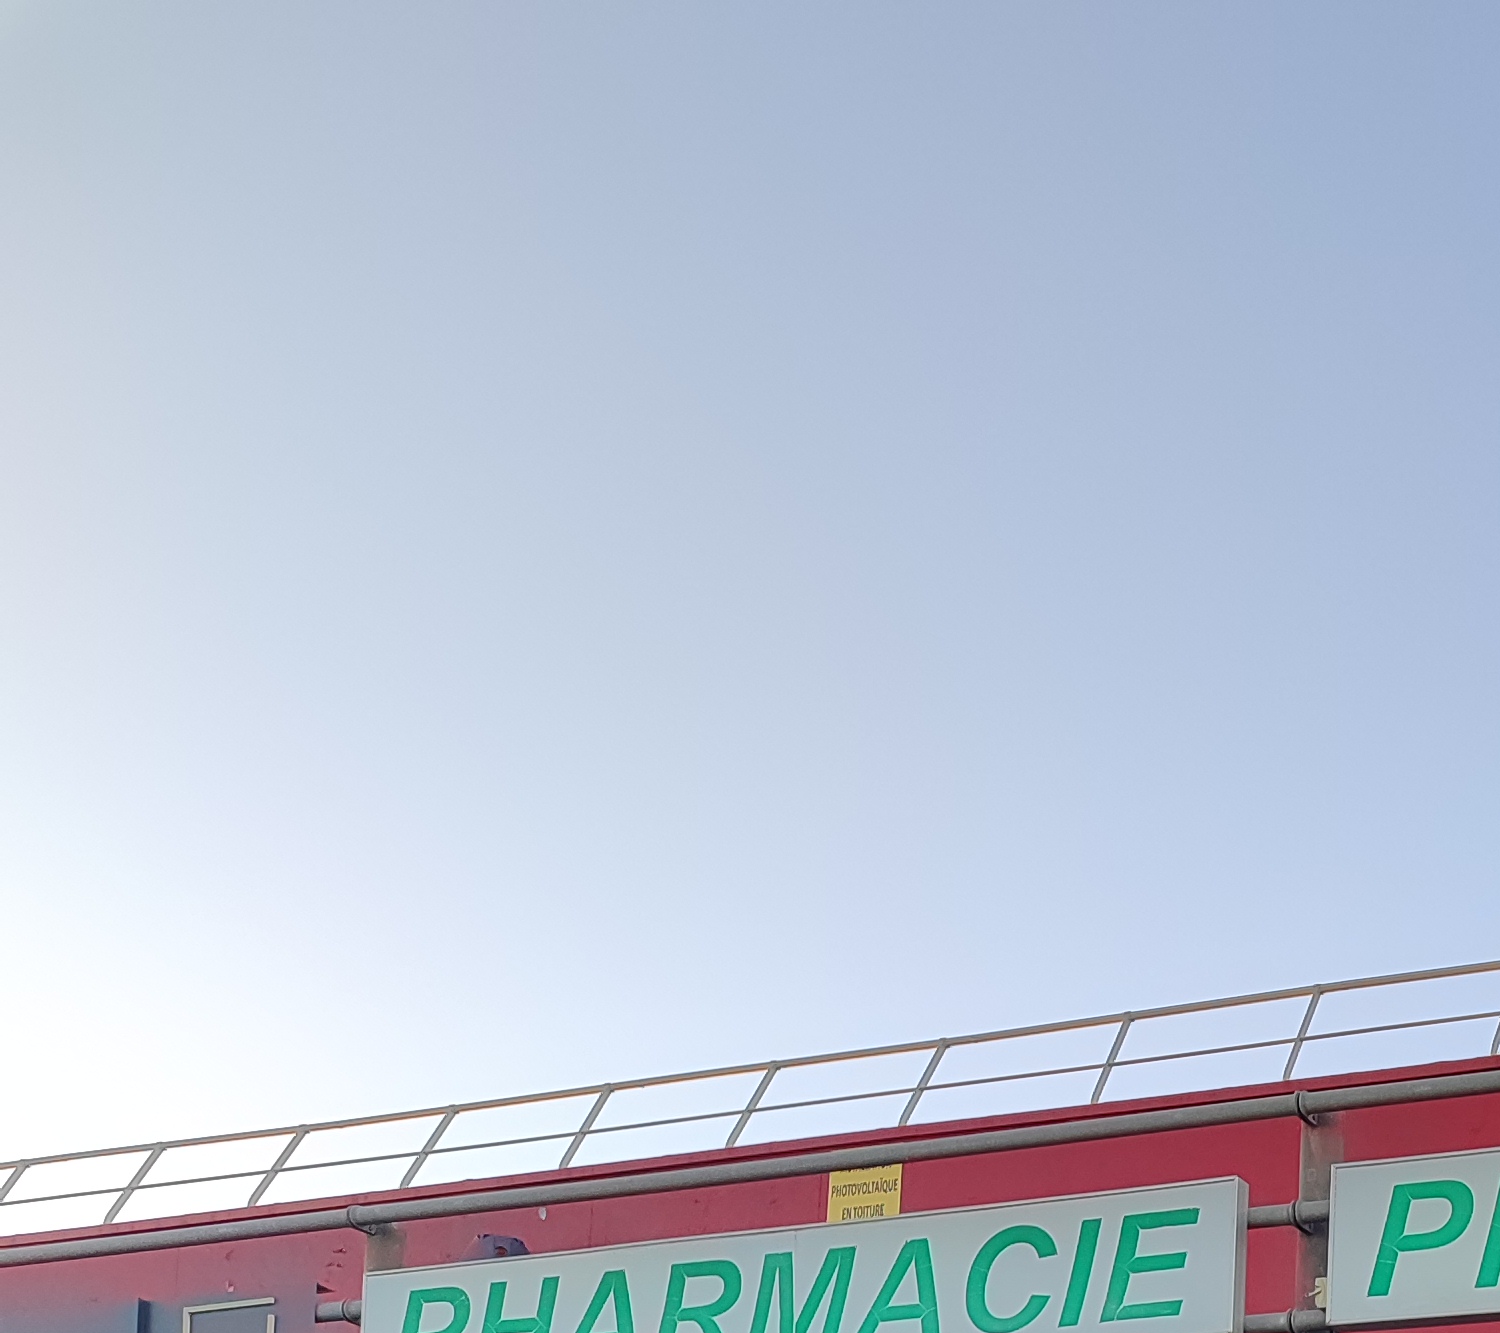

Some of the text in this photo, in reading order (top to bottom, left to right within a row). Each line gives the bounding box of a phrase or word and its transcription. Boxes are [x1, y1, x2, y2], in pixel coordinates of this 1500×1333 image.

[831, 1178, 898, 1198] PHOTOVOLTAÏQUE
[841, 1203, 885, 1220] EN TOITURE
